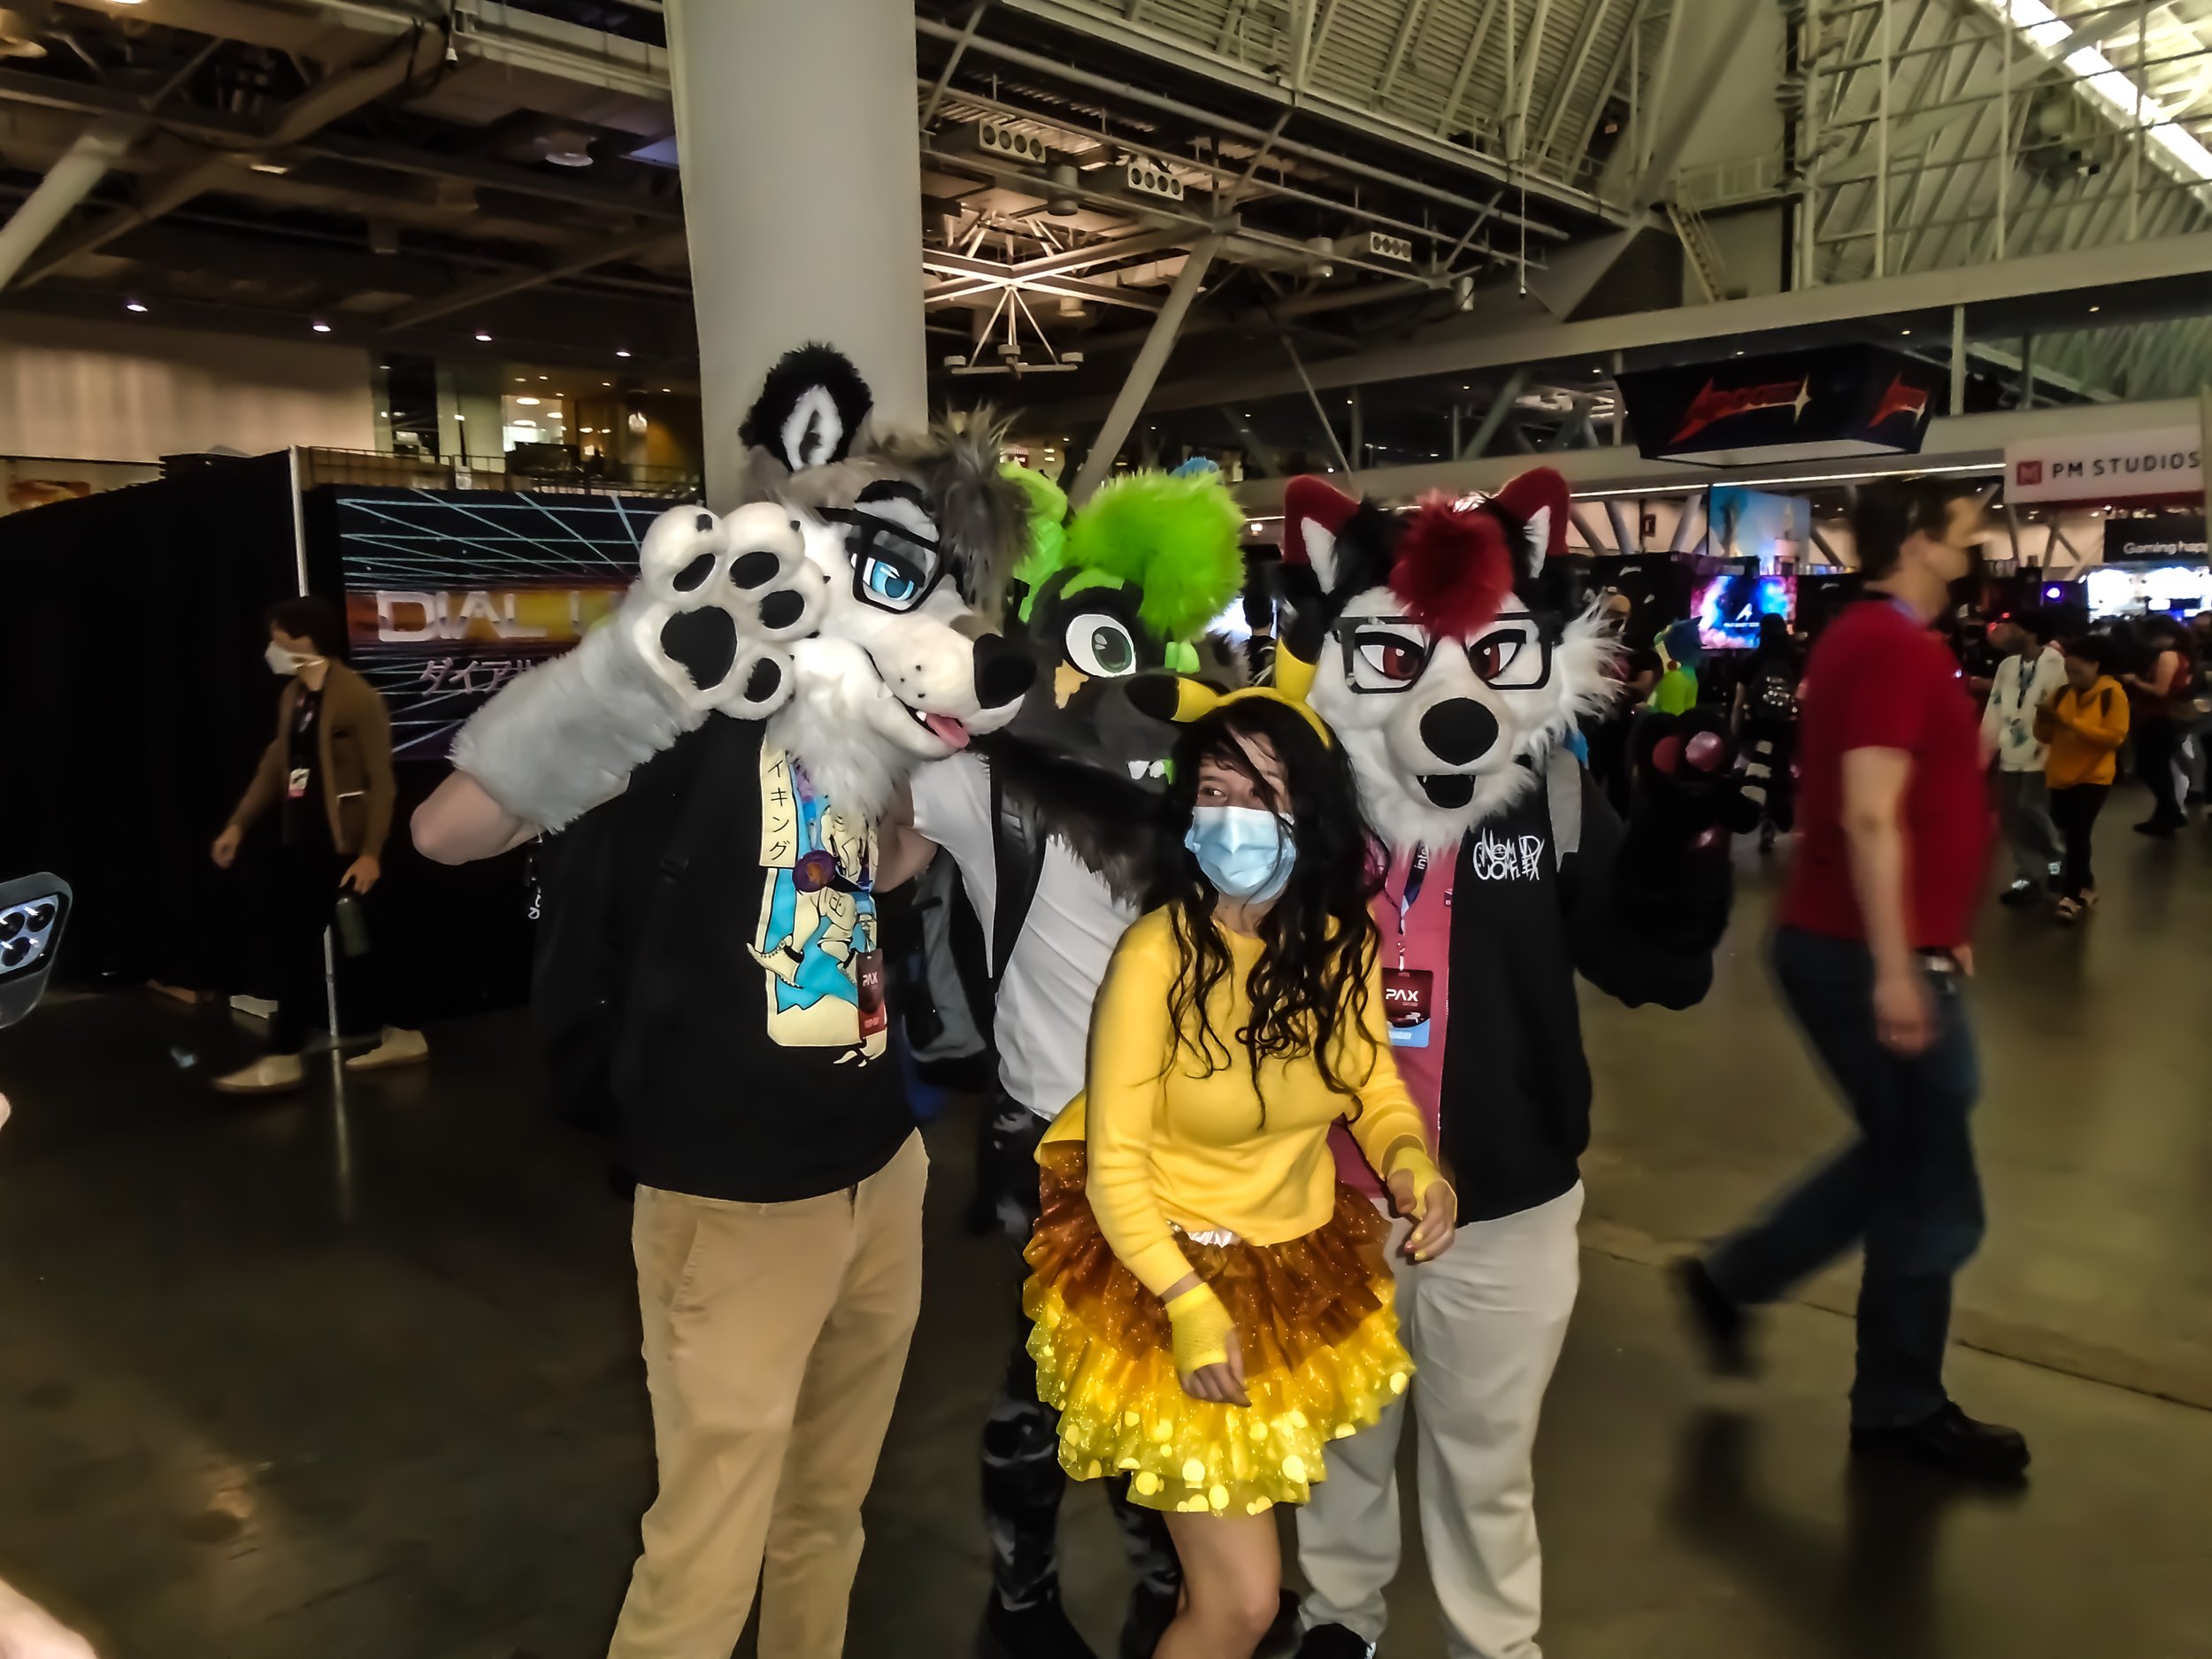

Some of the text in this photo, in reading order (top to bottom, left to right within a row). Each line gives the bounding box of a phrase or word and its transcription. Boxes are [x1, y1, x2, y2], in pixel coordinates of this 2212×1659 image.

[2052, 450, 2201, 479] PM STUDIOS
[2124, 541, 2176, 555] Gaming
[376, 590, 547, 642] DIAL
[766, 759, 791, 861] イキング
[1413, 847, 1428, 870] inte
[862, 972, 879, 987] PAX
[1385, 988, 1419, 1002] PAX
